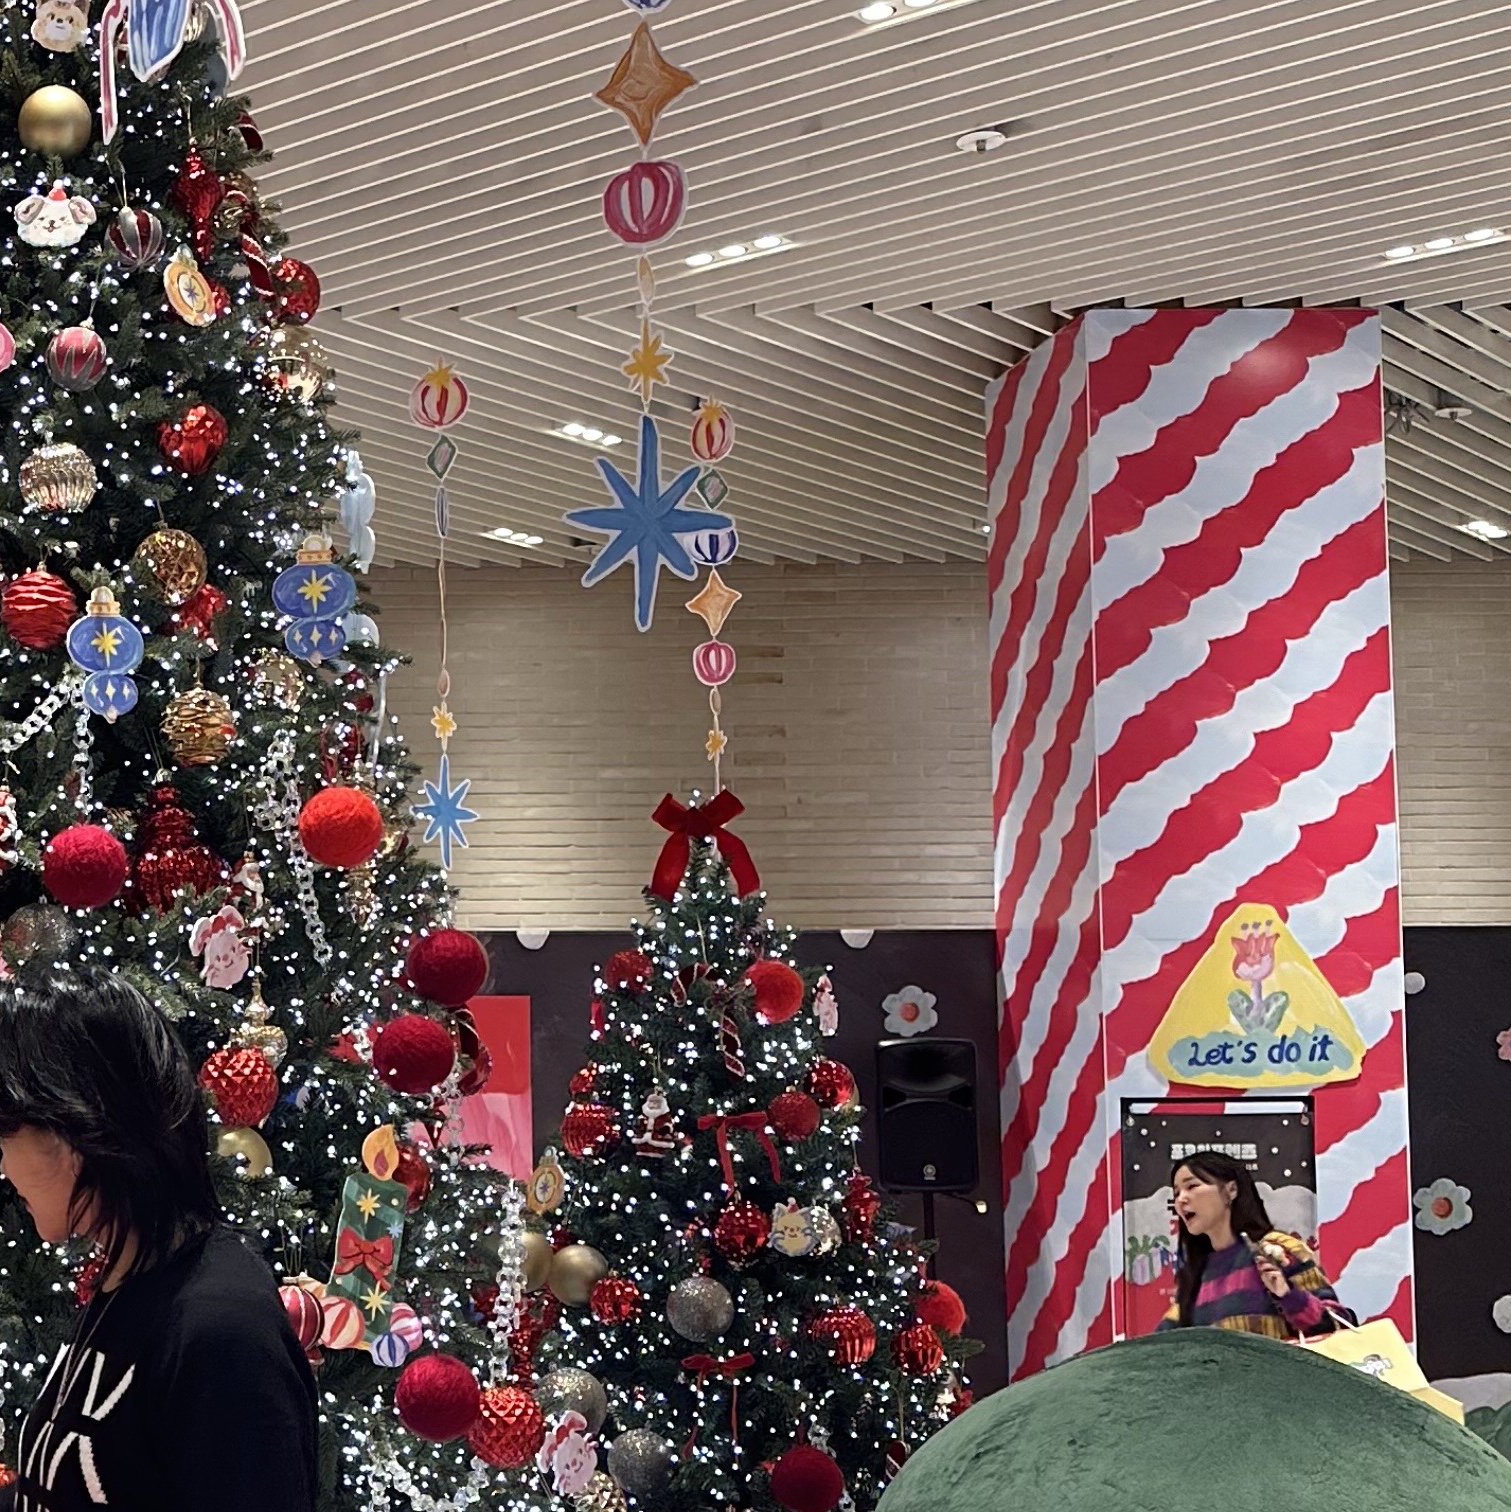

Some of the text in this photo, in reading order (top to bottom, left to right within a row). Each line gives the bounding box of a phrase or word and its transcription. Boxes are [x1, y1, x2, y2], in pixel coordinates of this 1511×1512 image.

[1188, 1034, 1334, 1067] Let's do it
